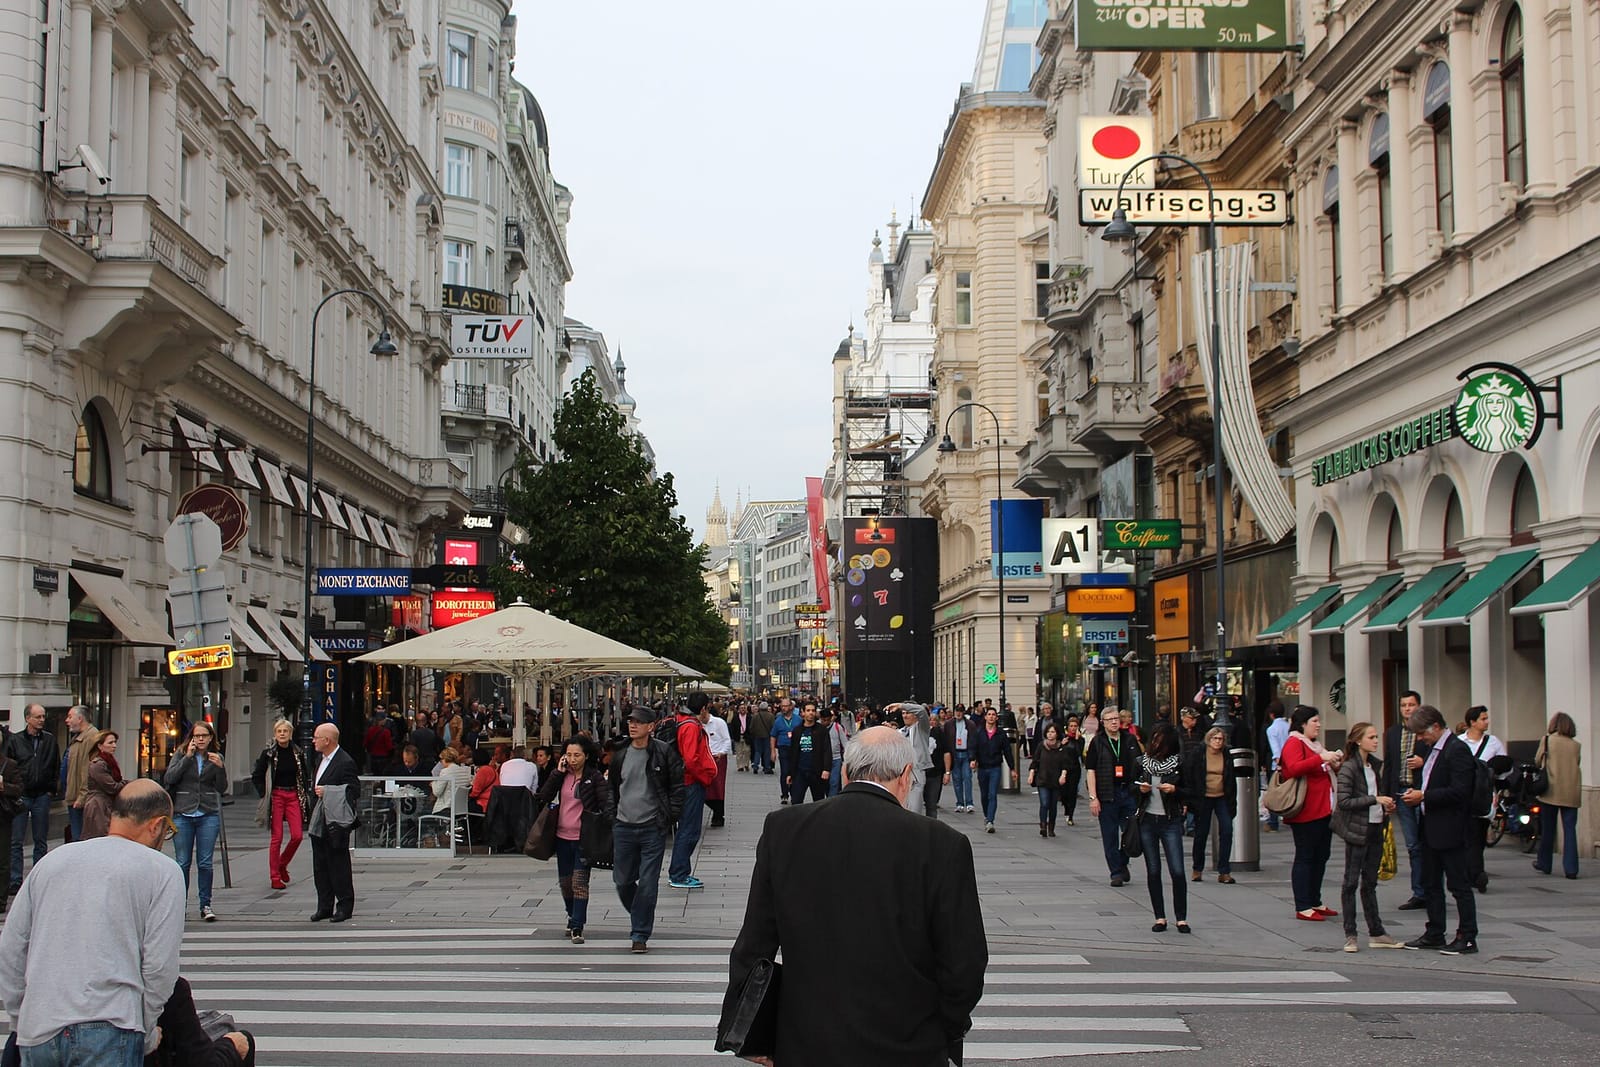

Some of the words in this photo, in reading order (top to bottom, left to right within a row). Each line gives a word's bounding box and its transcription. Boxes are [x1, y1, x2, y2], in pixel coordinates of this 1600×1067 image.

[1096, 8, 1126, 23] zur
[1126, 7, 1206, 29] OPER
[1217, 27, 1236, 43] 50
[1238, 32, 1252, 42] m
[1087, 168, 1147, 185] Turek
[1311, 432, 1389, 487] STARBUCKS
[1390, 406, 1453, 459] COFFEE
[1115, 521, 1170, 547] Coiffeur
[1050, 525, 1089, 566] A1
[319, 575, 354, 588] MONEY
[356, 575, 409, 588] EXCHANGE
[435, 600, 496, 610] DOROTHEUM
[873, 589, 889, 606] 7
[451, 609, 480, 619] juwelier
[315, 638, 365, 649] HANGE
[1085, 631, 1117, 640] ERSTE
